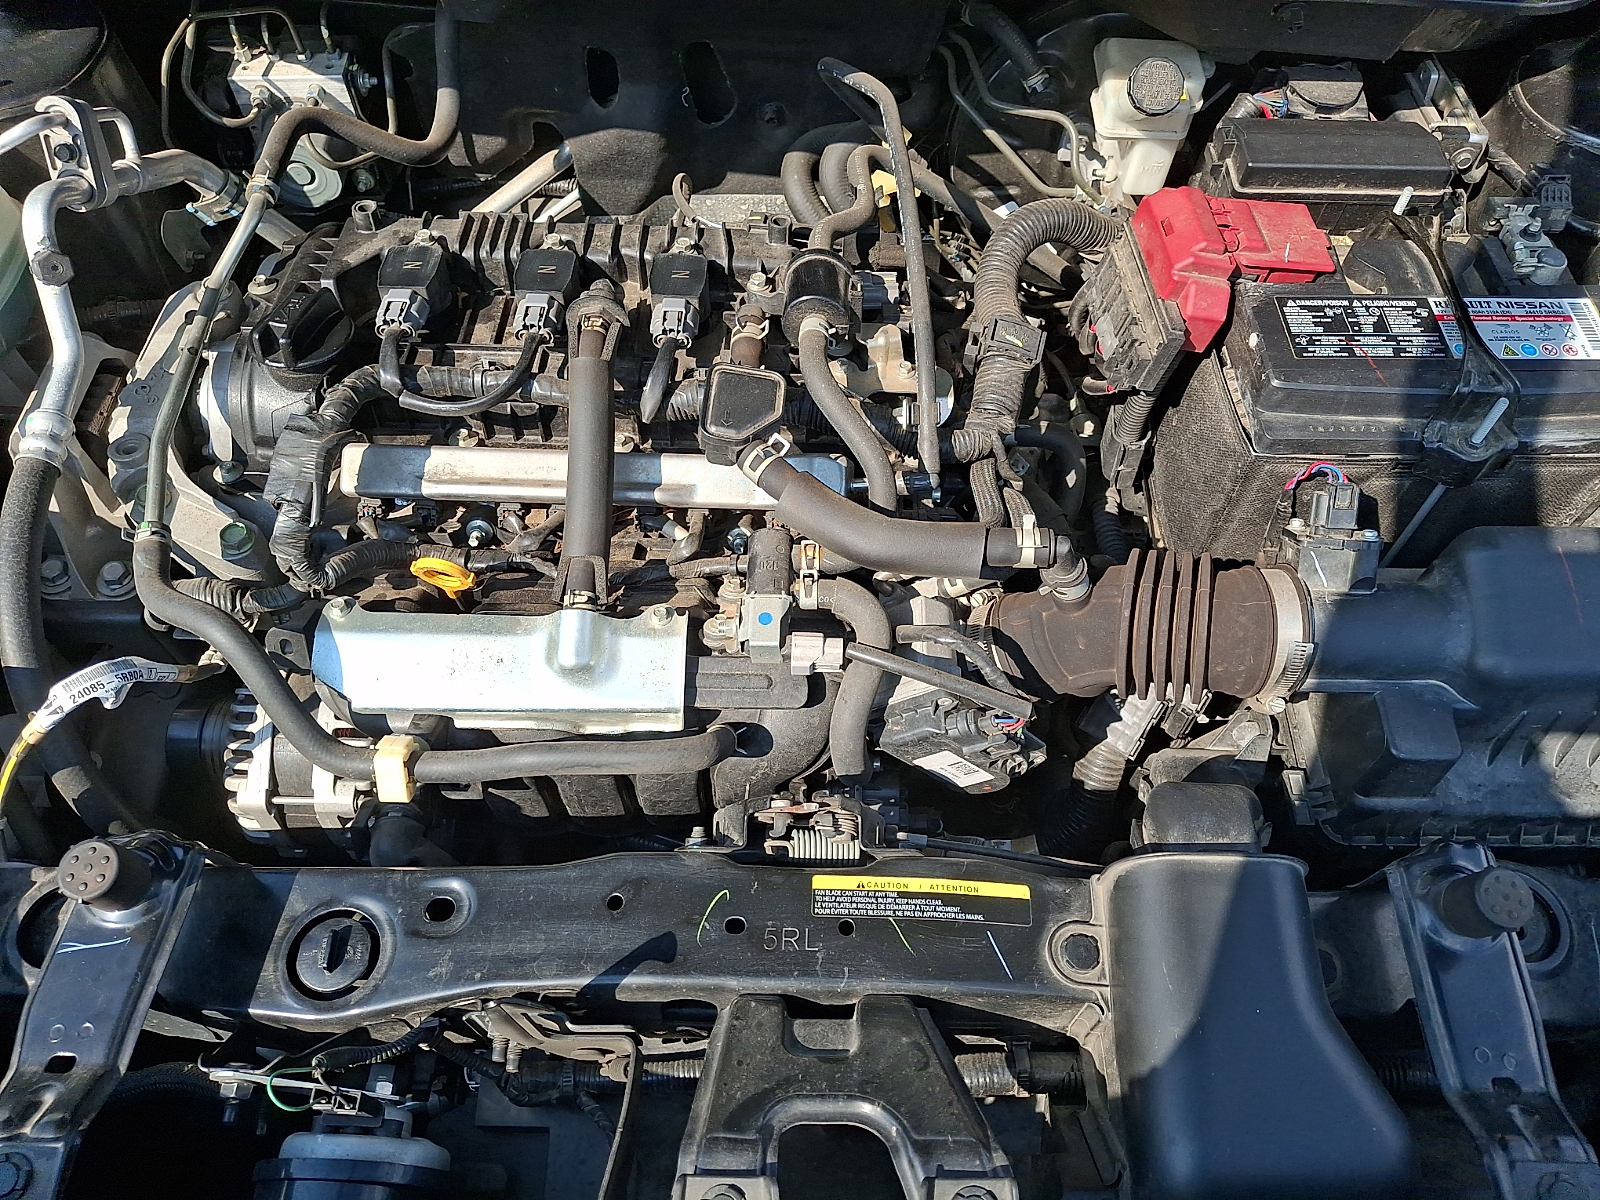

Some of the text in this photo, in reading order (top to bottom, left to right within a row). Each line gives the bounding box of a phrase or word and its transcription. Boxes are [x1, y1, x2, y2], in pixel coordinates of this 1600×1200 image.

[1495, 301, 1564, 309] NISSAN
[866, 881, 909, 889] CAUTION
[930, 884, 979, 893] ATTENTION
[763, 927, 819, 950] 5RL
